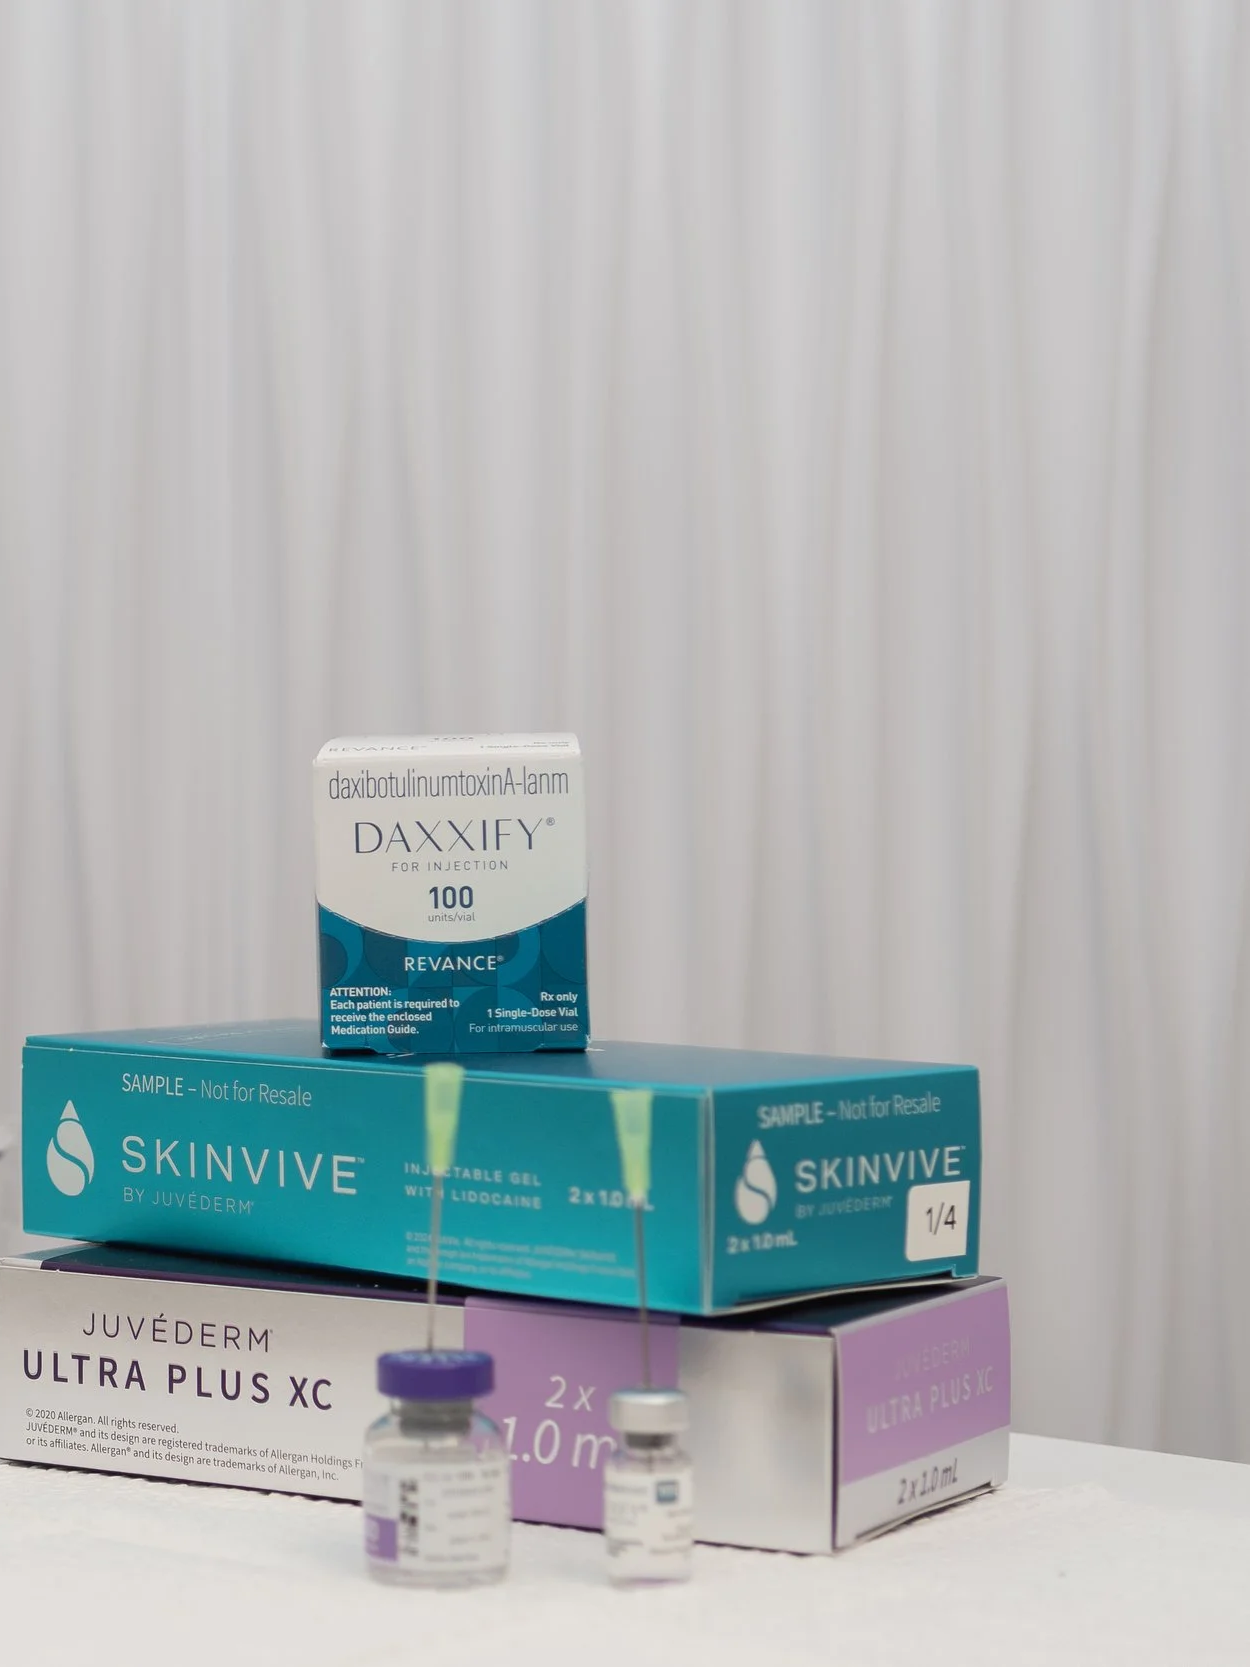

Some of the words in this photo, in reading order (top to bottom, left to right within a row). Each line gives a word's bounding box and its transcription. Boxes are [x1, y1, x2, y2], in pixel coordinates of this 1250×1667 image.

[329, 766, 569, 800] daxibotulinumtoxinA-lanm
[391, 861, 420, 872] FOR
[427, 860, 509, 872] INJECTION
[428, 885, 474, 910] 100
[427, 911, 476, 923] units/vial
[330, 986, 392, 997] ATTENTION:
[540, 992, 554, 1002] Rx
[556, 991, 578, 1004] only
[330, 999, 355, 1010] Each
[356, 999, 392, 1012] patient
[393, 999, 403, 1009] is
[404, 998, 448, 1011] required
[449, 998, 460, 1008] to
[330, 1013, 367, 1022] receive
[368, 1011, 385, 1022] the
[387, 1011, 433, 1022] enclosed
[487, 1008, 493, 1018] 1
[495, 1007, 557, 1020] Single-Dose
[559, 1006, 579, 1018] Vial
[331, 1024, 386, 1035] Medication
[387, 1024, 420, 1035] Guide.
[469, 1023, 485, 1033] For
[488, 1022, 559, 1033] intramuscular
[561, 1023, 579, 1032] use
[121, 1072, 184, 1097] SAMPLE
[200, 1079, 229, 1101] Not
[232, 1079, 256, 1103] for
[259, 1083, 312, 1107] Resale
[757, 1101, 824, 1129] SAMPLE
[838, 1099, 867, 1121] Not
[869, 1095, 890, 1118] for
[894, 1091, 941, 1116] Resale
[404, 1161, 503, 1183] INJCTABLE
[509, 1171, 542, 1187] GEL
[123, 1187, 145, 1203] BY
[452, 1189, 542, 1210] LIDOCAINE
[795, 1203, 816, 1219] BY
[925, 1201, 958, 1236] 1/4
[23, 1349, 146, 1392] ULTRA
[167, 1363, 270, 1405] PLUS
[289, 1375, 333, 1411] XC
[544, 1375, 567, 1409] 2
[573, 1384, 597, 1412] x
[866, 1390, 924, 1435] ULTRA
[929, 1373, 971, 1414] PLUS
[975, 1365, 994, 1397] XC
[35, 1408, 56, 1420] 2020
[57, 1410, 96, 1426] Allergan.
[97, 1415, 109, 1426] All
[110, 1417, 136, 1430] rights
[138, 1421, 180, 1434] reserved.
[79, 1428, 96, 1439] and
[98, 1429, 109, 1440] its
[110, 1430, 140, 1445] design
[141, 1435, 156, 1445] are
[158, 1436, 203, 1451] registered
[204, 1441, 258, 1457] trademarks
[259, 1447, 269, 1458] of
[270, 1448, 309, 1464] Allergan
[310, 1453, 353, 1470] Holdings
[502, 1415, 561, 1465] 1.0
[25, 1437, 35, 1446] or
[37, 1437, 48, 1447] its
[49, 1437, 89, 1453] affiliates.
[133, 1448, 150, 1459] and
[151, 1449, 163, 1461] its
[164, 1451, 195, 1466] design
[196, 1456, 212, 1467] are
[212, 1457, 266, 1473] trademarks
[267, 1462, 277, 1473] of
[278, 1464, 320, 1481] Allergan,
[321, 1469, 339, 1481] Inc.
[940, 1457, 959, 1487] mL
